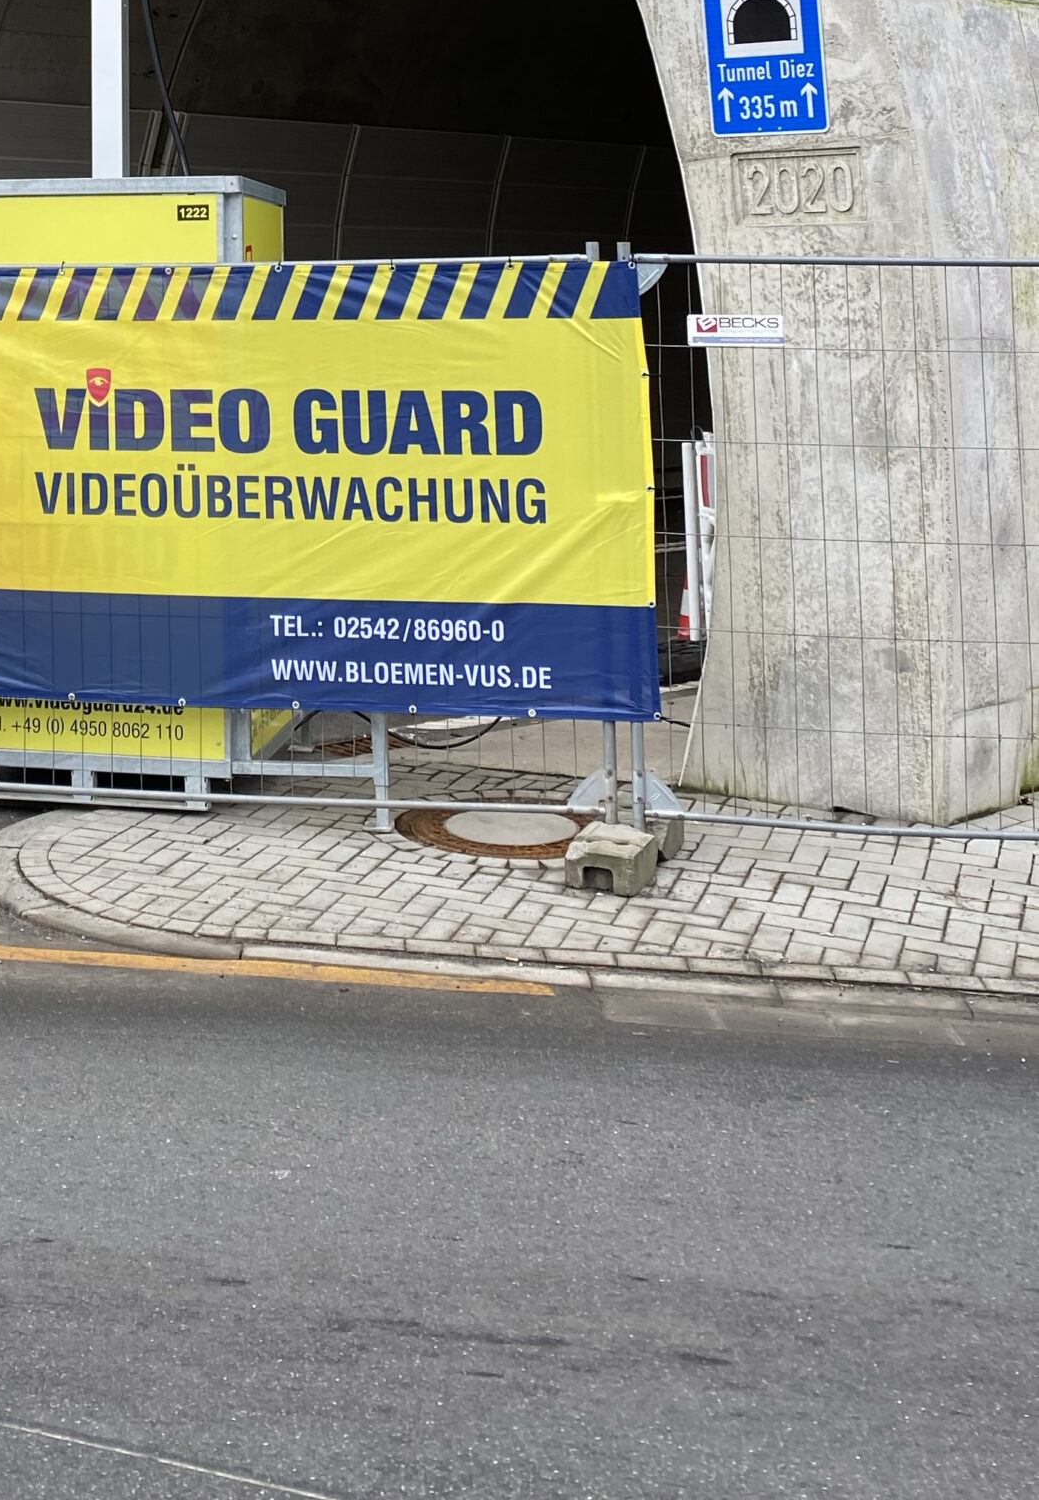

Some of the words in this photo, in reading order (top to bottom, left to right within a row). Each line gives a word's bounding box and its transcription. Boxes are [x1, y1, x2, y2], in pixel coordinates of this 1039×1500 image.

[717, 61, 772, 83] Tunnel
[779, 59, 815, 79] Diez
[738, 94, 776, 120] 335
[779, 99, 798, 118] m
[747, 160, 854, 215] 2020
[179, 207, 208, 218] 1222
[718, 317, 779, 328] BECKS
[293, 388, 543, 456] GUARD
[34, 463, 548, 525] VIDEOÜBERWACHUNG
[270, 614, 323, 637] TEL.:
[271, 658, 552, 689] WWW.BLOEMEN-VUS.DE
[12, 716, 41, 733] +49
[46, 716, 65, 736] (0)
[69, 719, 107, 738] 4950
[112, 721, 150, 739] 8062
[156, 724, 184, 741] 110
